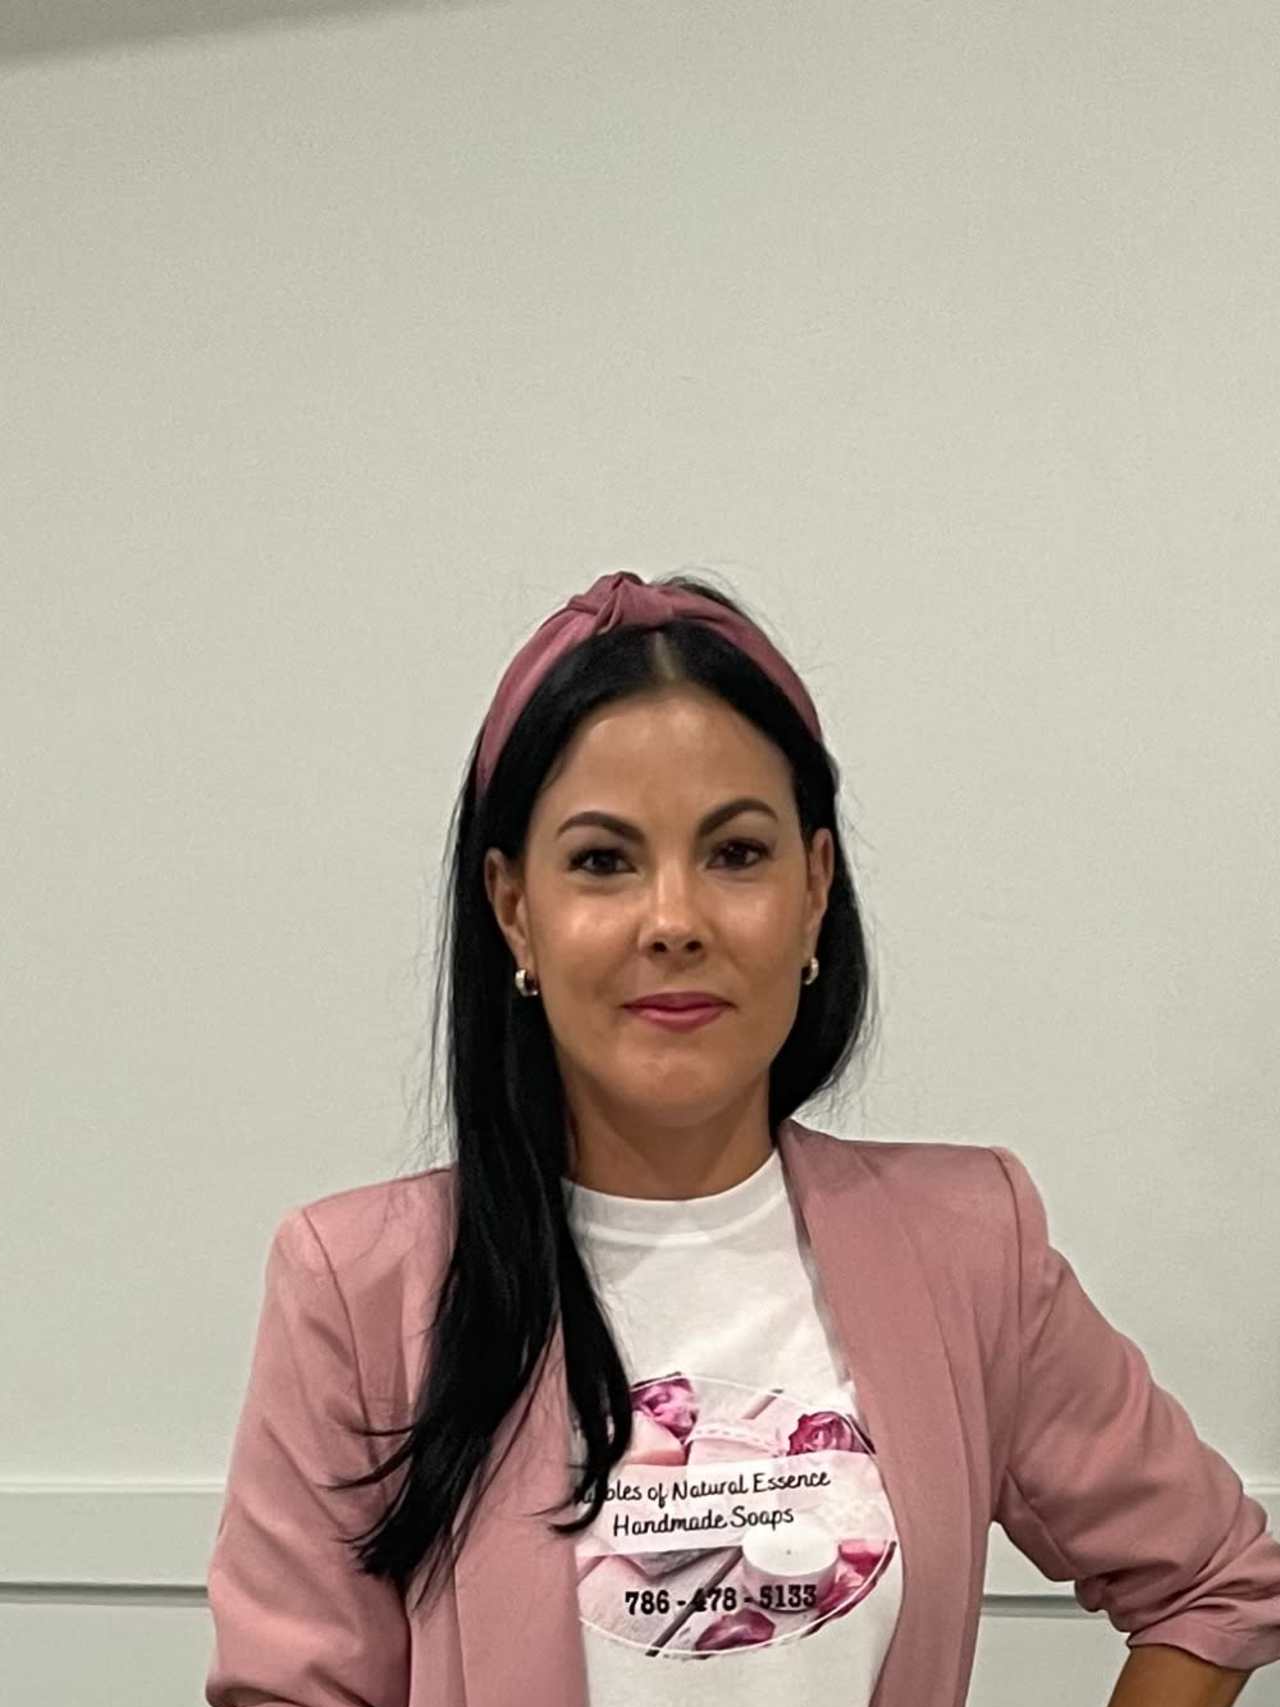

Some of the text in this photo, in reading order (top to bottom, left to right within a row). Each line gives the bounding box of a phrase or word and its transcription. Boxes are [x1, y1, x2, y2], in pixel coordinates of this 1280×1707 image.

[647, 1482, 669, 1509] of
[672, 1473, 749, 1501] Natural
[752, 1471, 832, 1494] Essence
[613, 1505, 795, 1537] Handmade Soaps
[625, 1590, 670, 1615] 786
[692, 1587, 737, 1612] 478
[759, 1584, 817, 1609] 5133
